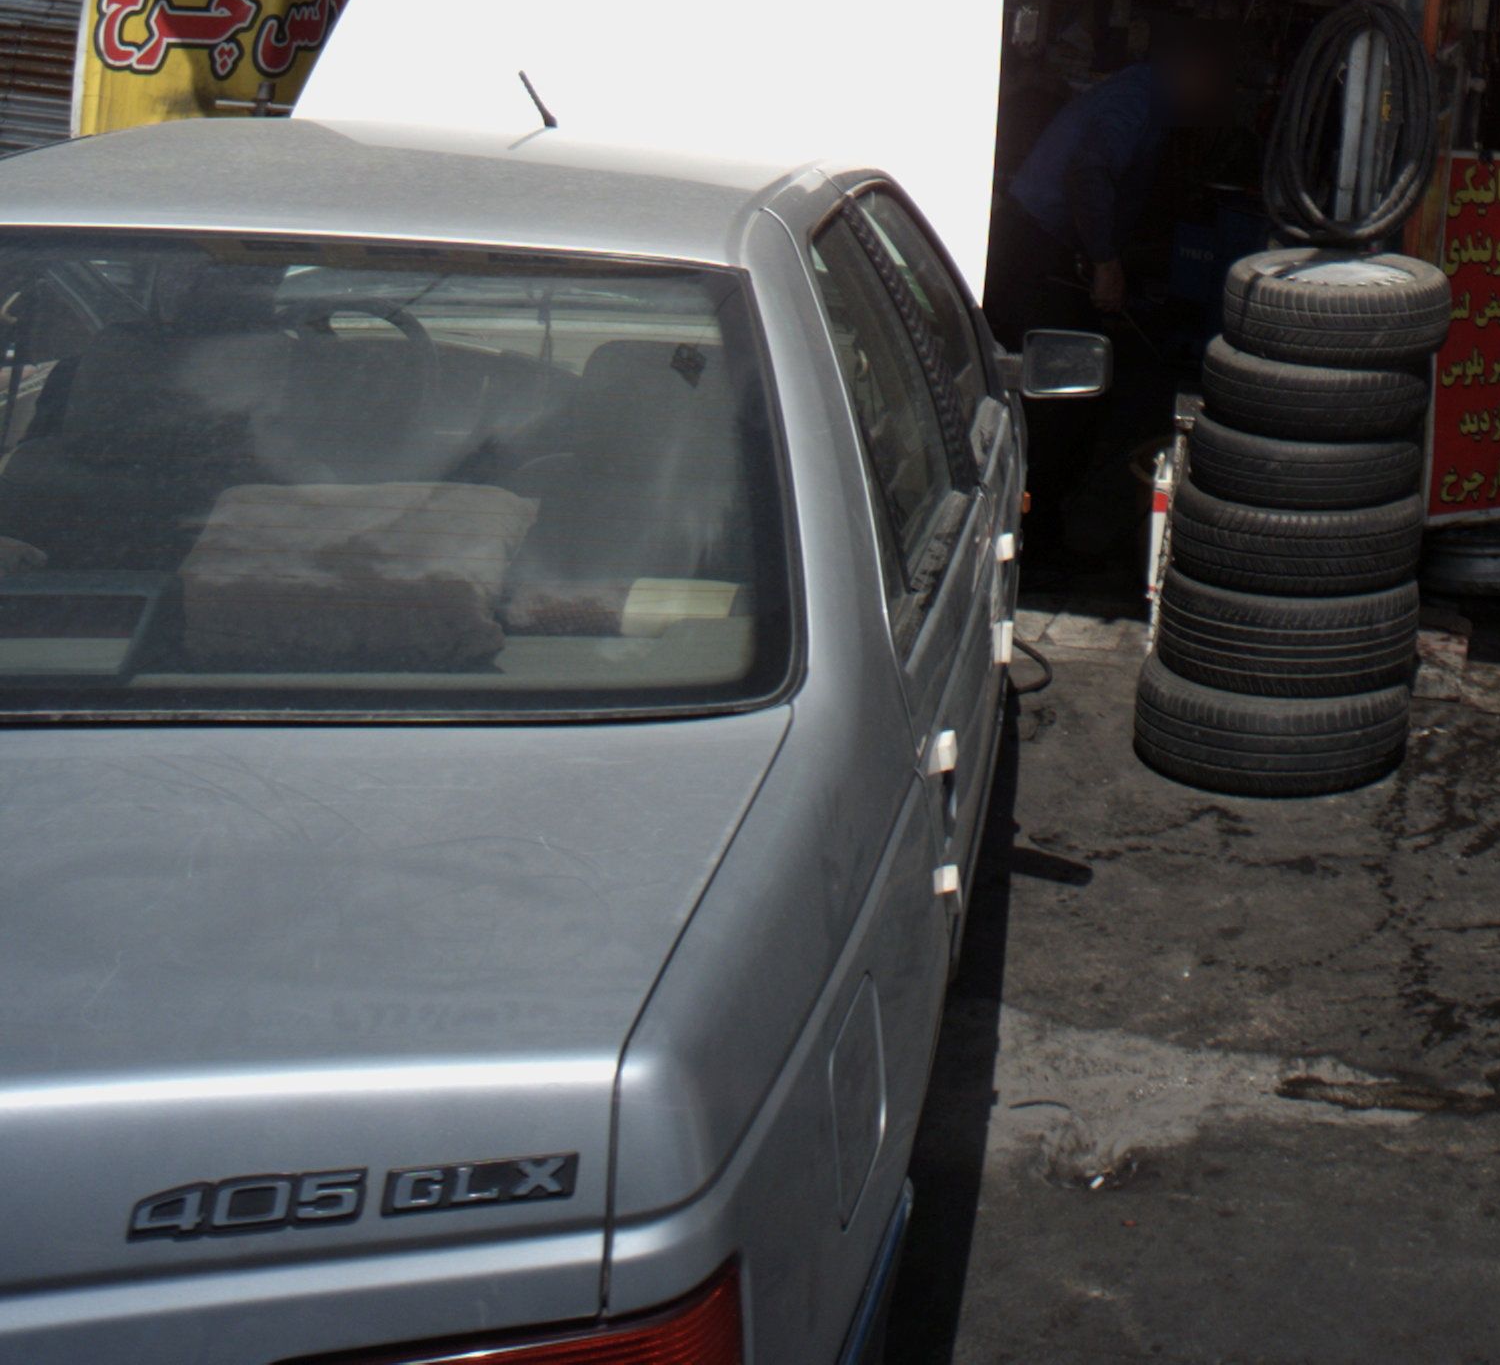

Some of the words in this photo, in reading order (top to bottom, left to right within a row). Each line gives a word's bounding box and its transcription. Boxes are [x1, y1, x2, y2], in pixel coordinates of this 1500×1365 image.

[1440, 345, 1485, 388] پلوس
[1439, 466, 1486, 504] چرخ
[130, 1170, 366, 1239] 405
[398, 1156, 573, 1213] GLX
